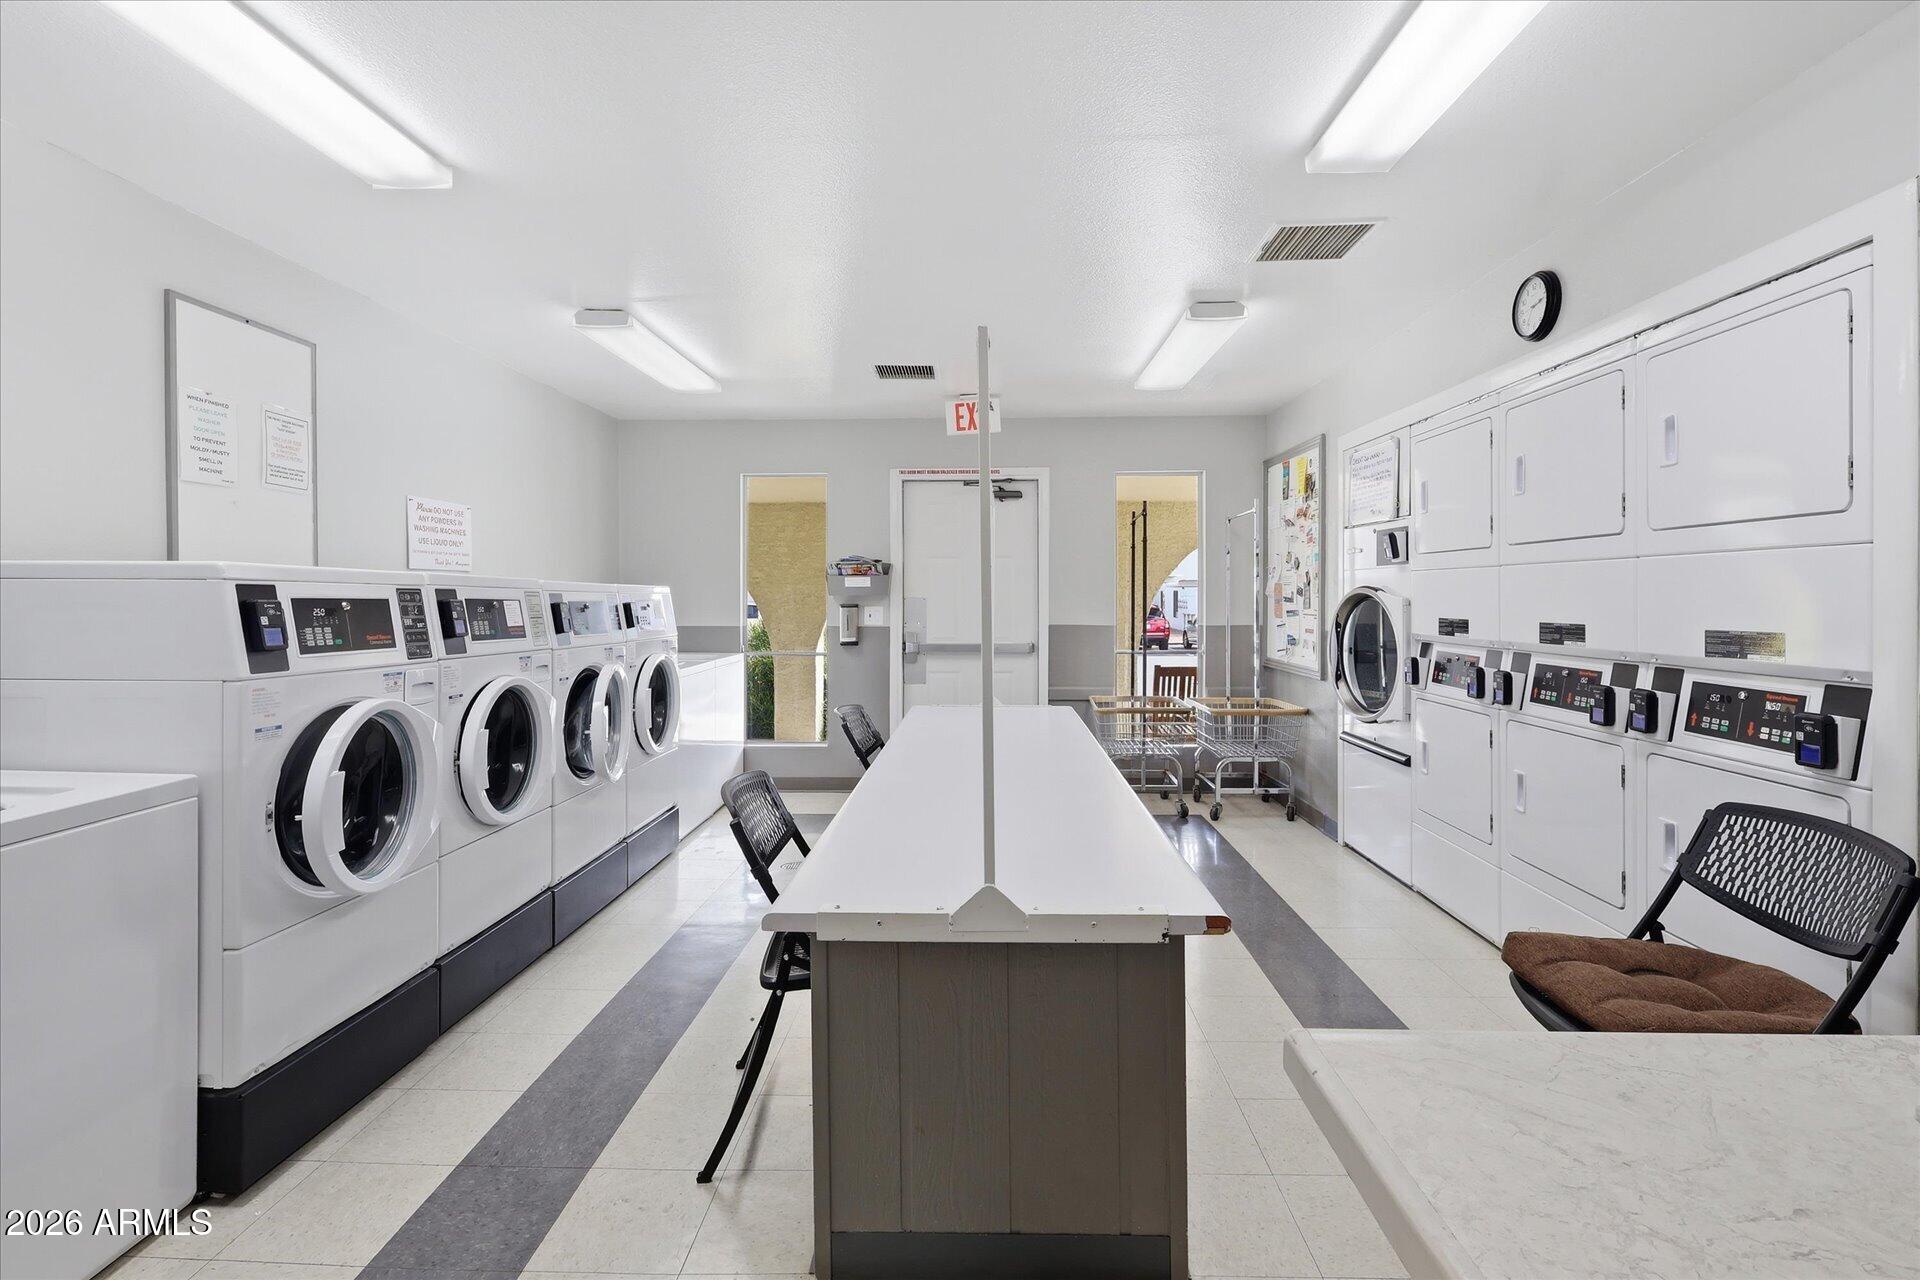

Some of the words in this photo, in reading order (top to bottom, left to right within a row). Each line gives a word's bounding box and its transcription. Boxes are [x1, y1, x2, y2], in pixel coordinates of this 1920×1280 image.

[186, 394, 203, 402] WHEN
[203, 399, 230, 409] FINISHED
[955, 402, 979, 431] EX
[202, 437, 226, 446] PREVENT
[190, 445, 230, 456] MOLDY/MUSTY
[198, 456, 216, 464] SMELL
[198, 466, 223, 474] MACHINE
[416, 502, 432, 513] Please
[434, 507, 441, 515] DO
[431, 516, 456, 526] POWDERS
[414, 524, 438, 534] WASHING
[440, 528, 466, 536] MACHINES
[431, 538, 448, 546] LIQUID
